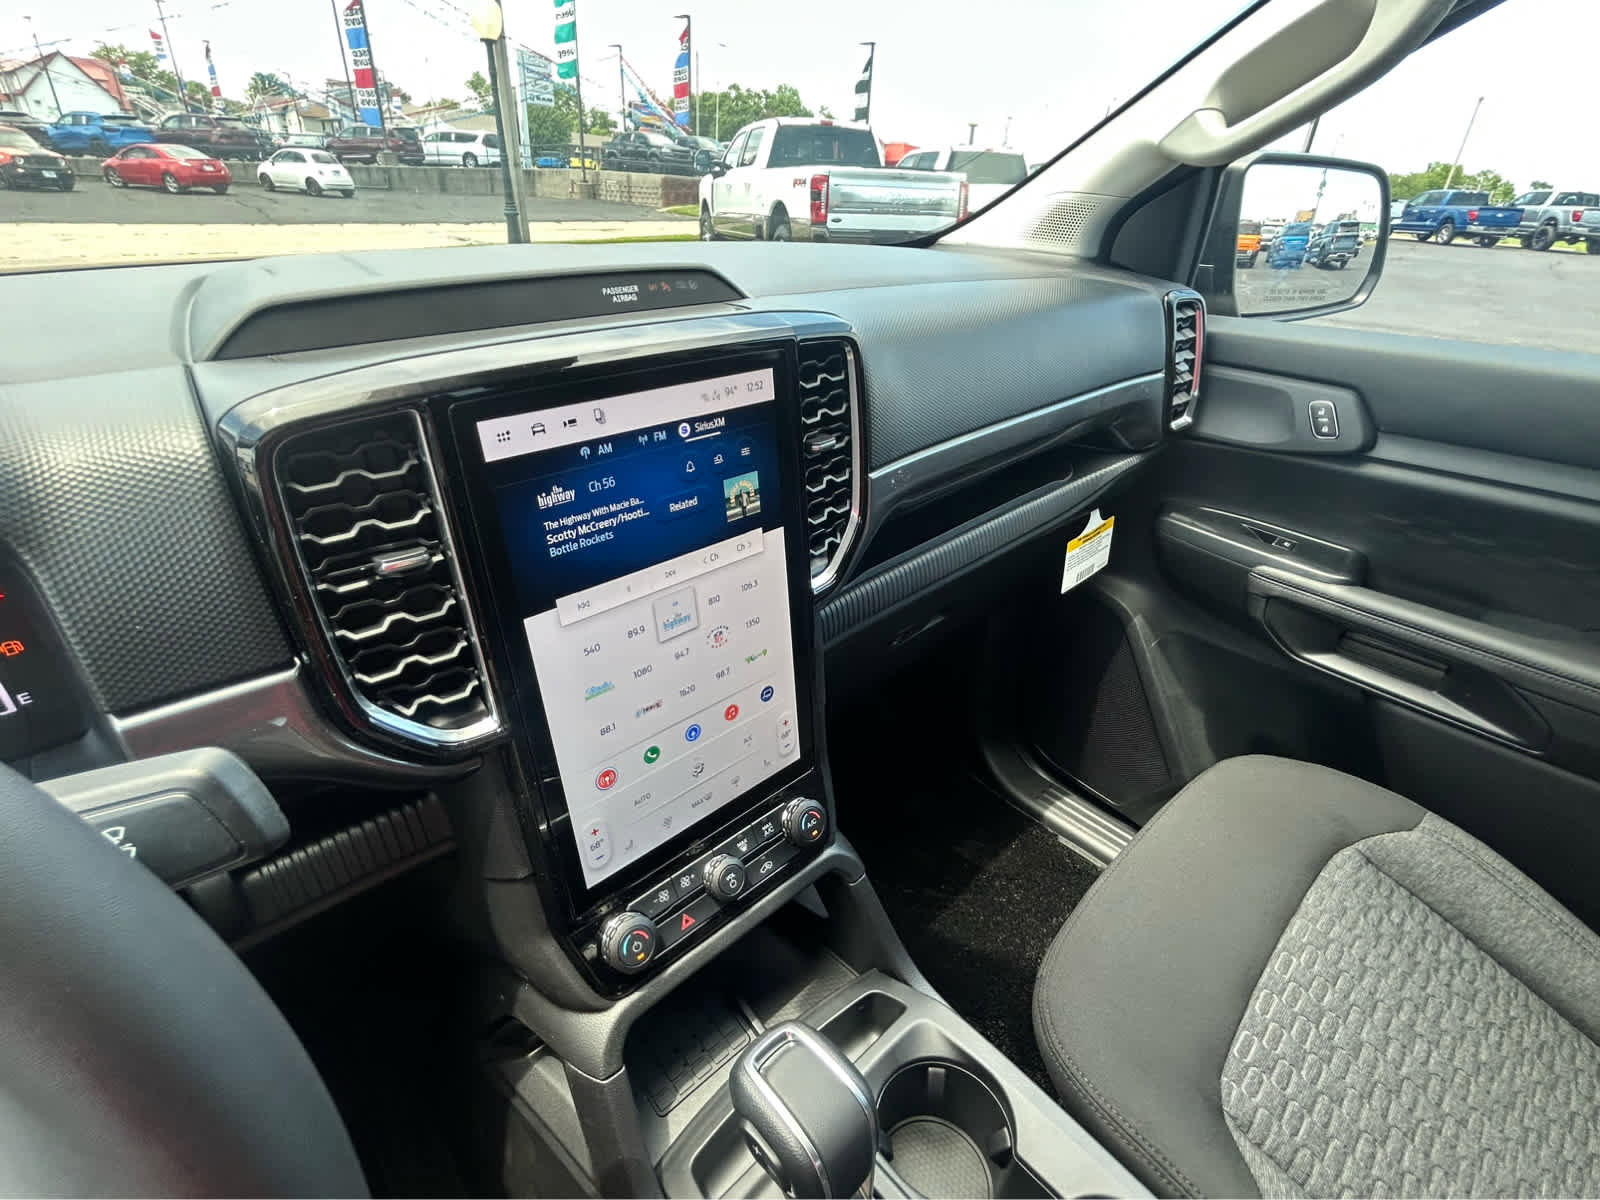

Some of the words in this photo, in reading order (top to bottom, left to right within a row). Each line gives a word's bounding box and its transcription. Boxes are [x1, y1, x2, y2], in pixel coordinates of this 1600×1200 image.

[601, 285, 639, 296] PASSENGER
[612, 293, 638, 304] AIRBAG
[694, 417, 726, 433] SiriusXM
[653, 431, 667, 442] FM
[598, 443, 613, 456] AM
[552, 484, 563, 494] the
[588, 480, 602, 493] Ch
[602, 476, 616, 489] 56
[537, 488, 576, 510] highway
[669, 496, 698, 513] Related
[543, 521, 559, 532] The
[560, 511, 592, 527] Highway
[591, 505, 610, 518] With
[546, 527, 577, 545] Scotty
[549, 541, 579, 558] Bottle
[579, 531, 615, 549] Rockets
[627, 625, 646, 639] 89.9
[583, 643, 601, 656] 540
[16, 692, 33, 705] E
